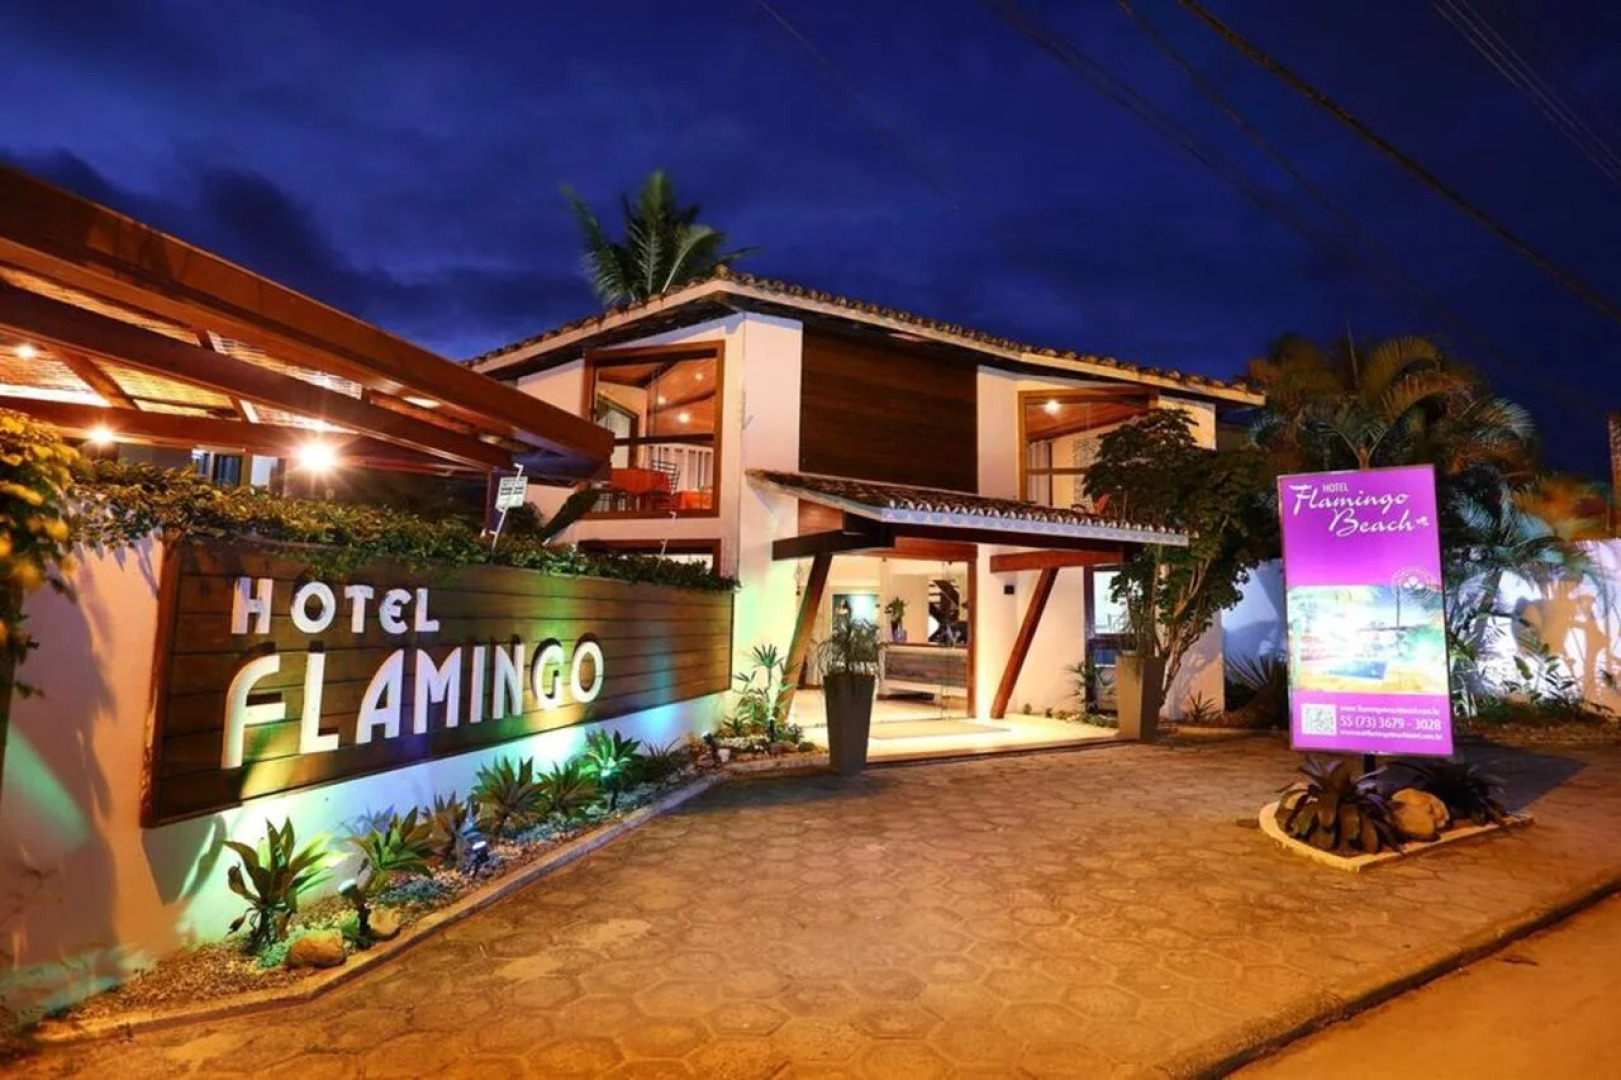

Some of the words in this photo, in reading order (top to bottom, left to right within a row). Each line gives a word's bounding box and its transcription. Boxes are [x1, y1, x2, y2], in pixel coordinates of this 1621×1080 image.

[1289, 484, 1410, 516] Flamingo
[1322, 482, 1349, 493] HOTEL
[1328, 508, 1415, 537] Beach
[231, 577, 440, 635] HOTEL
[221, 641, 605, 769] FLAMINGO
[1355, 715, 1376, 729] (73)
